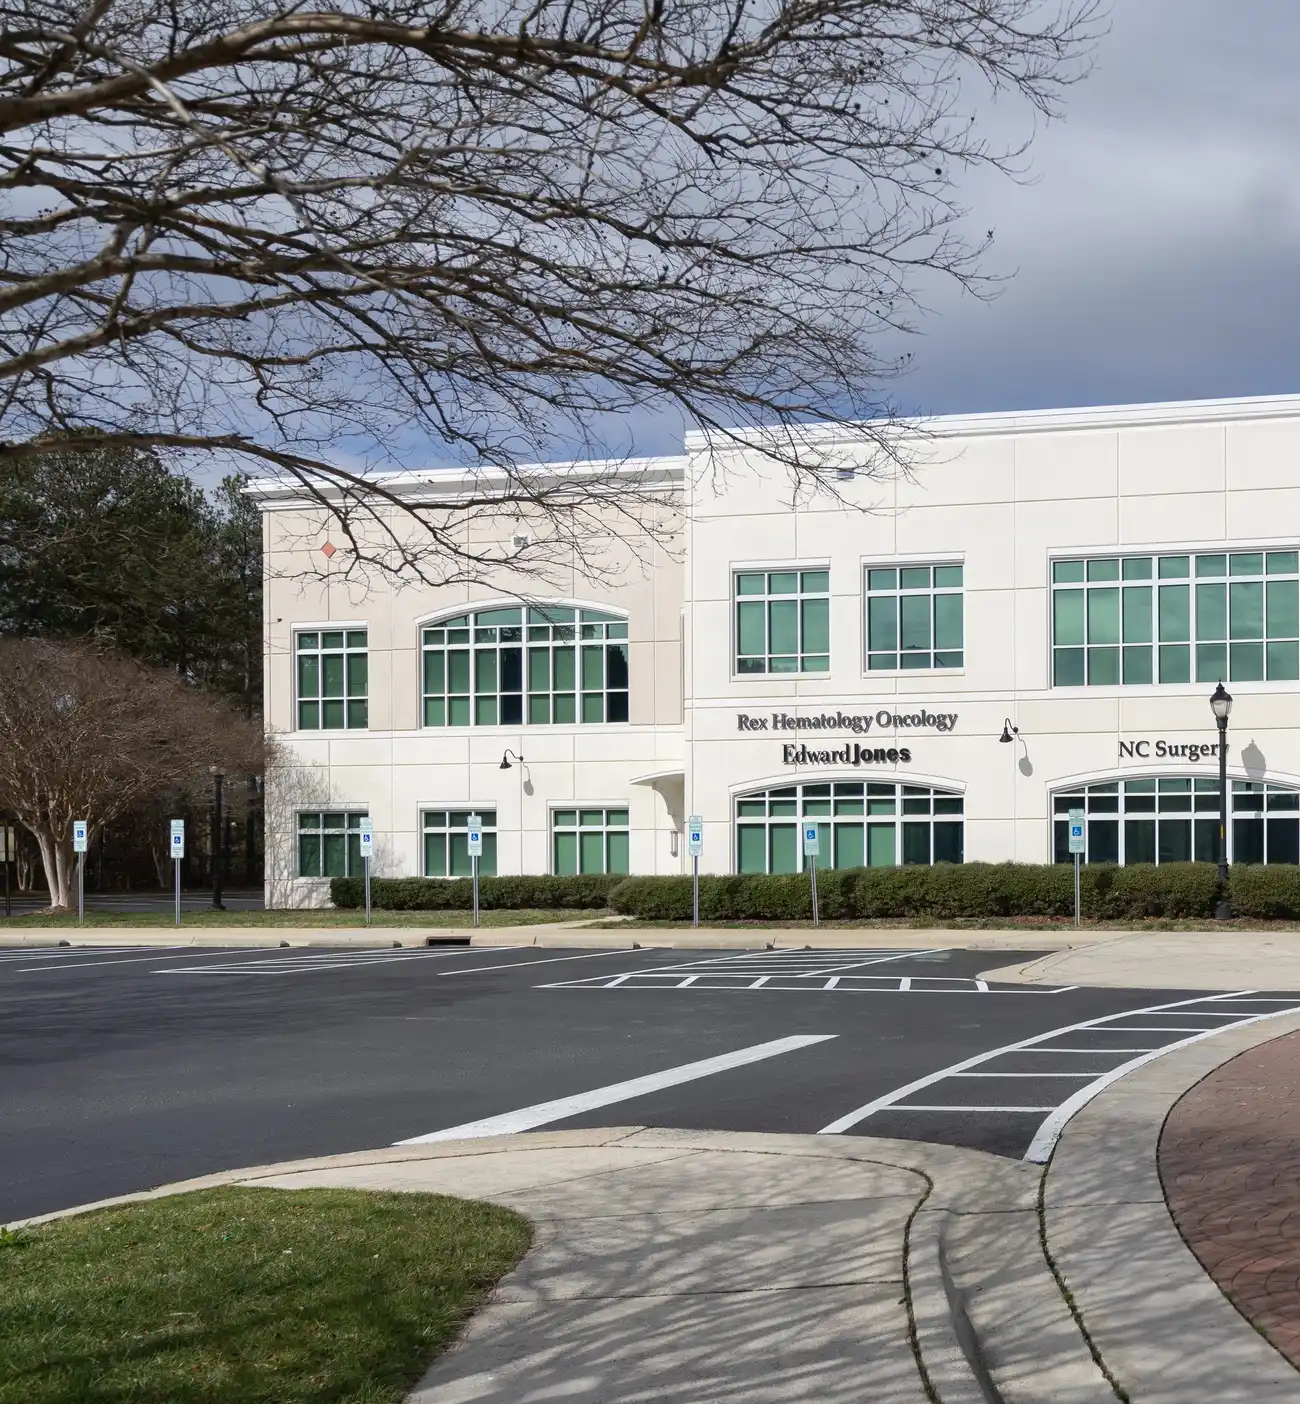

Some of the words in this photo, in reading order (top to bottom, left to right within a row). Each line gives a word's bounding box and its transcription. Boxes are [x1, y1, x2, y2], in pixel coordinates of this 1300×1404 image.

[737, 713, 768, 731] Rex
[772, 711, 873, 733] Hematology
[876, 709, 958, 732] Oncology
[1118, 740, 1150, 758] NC
